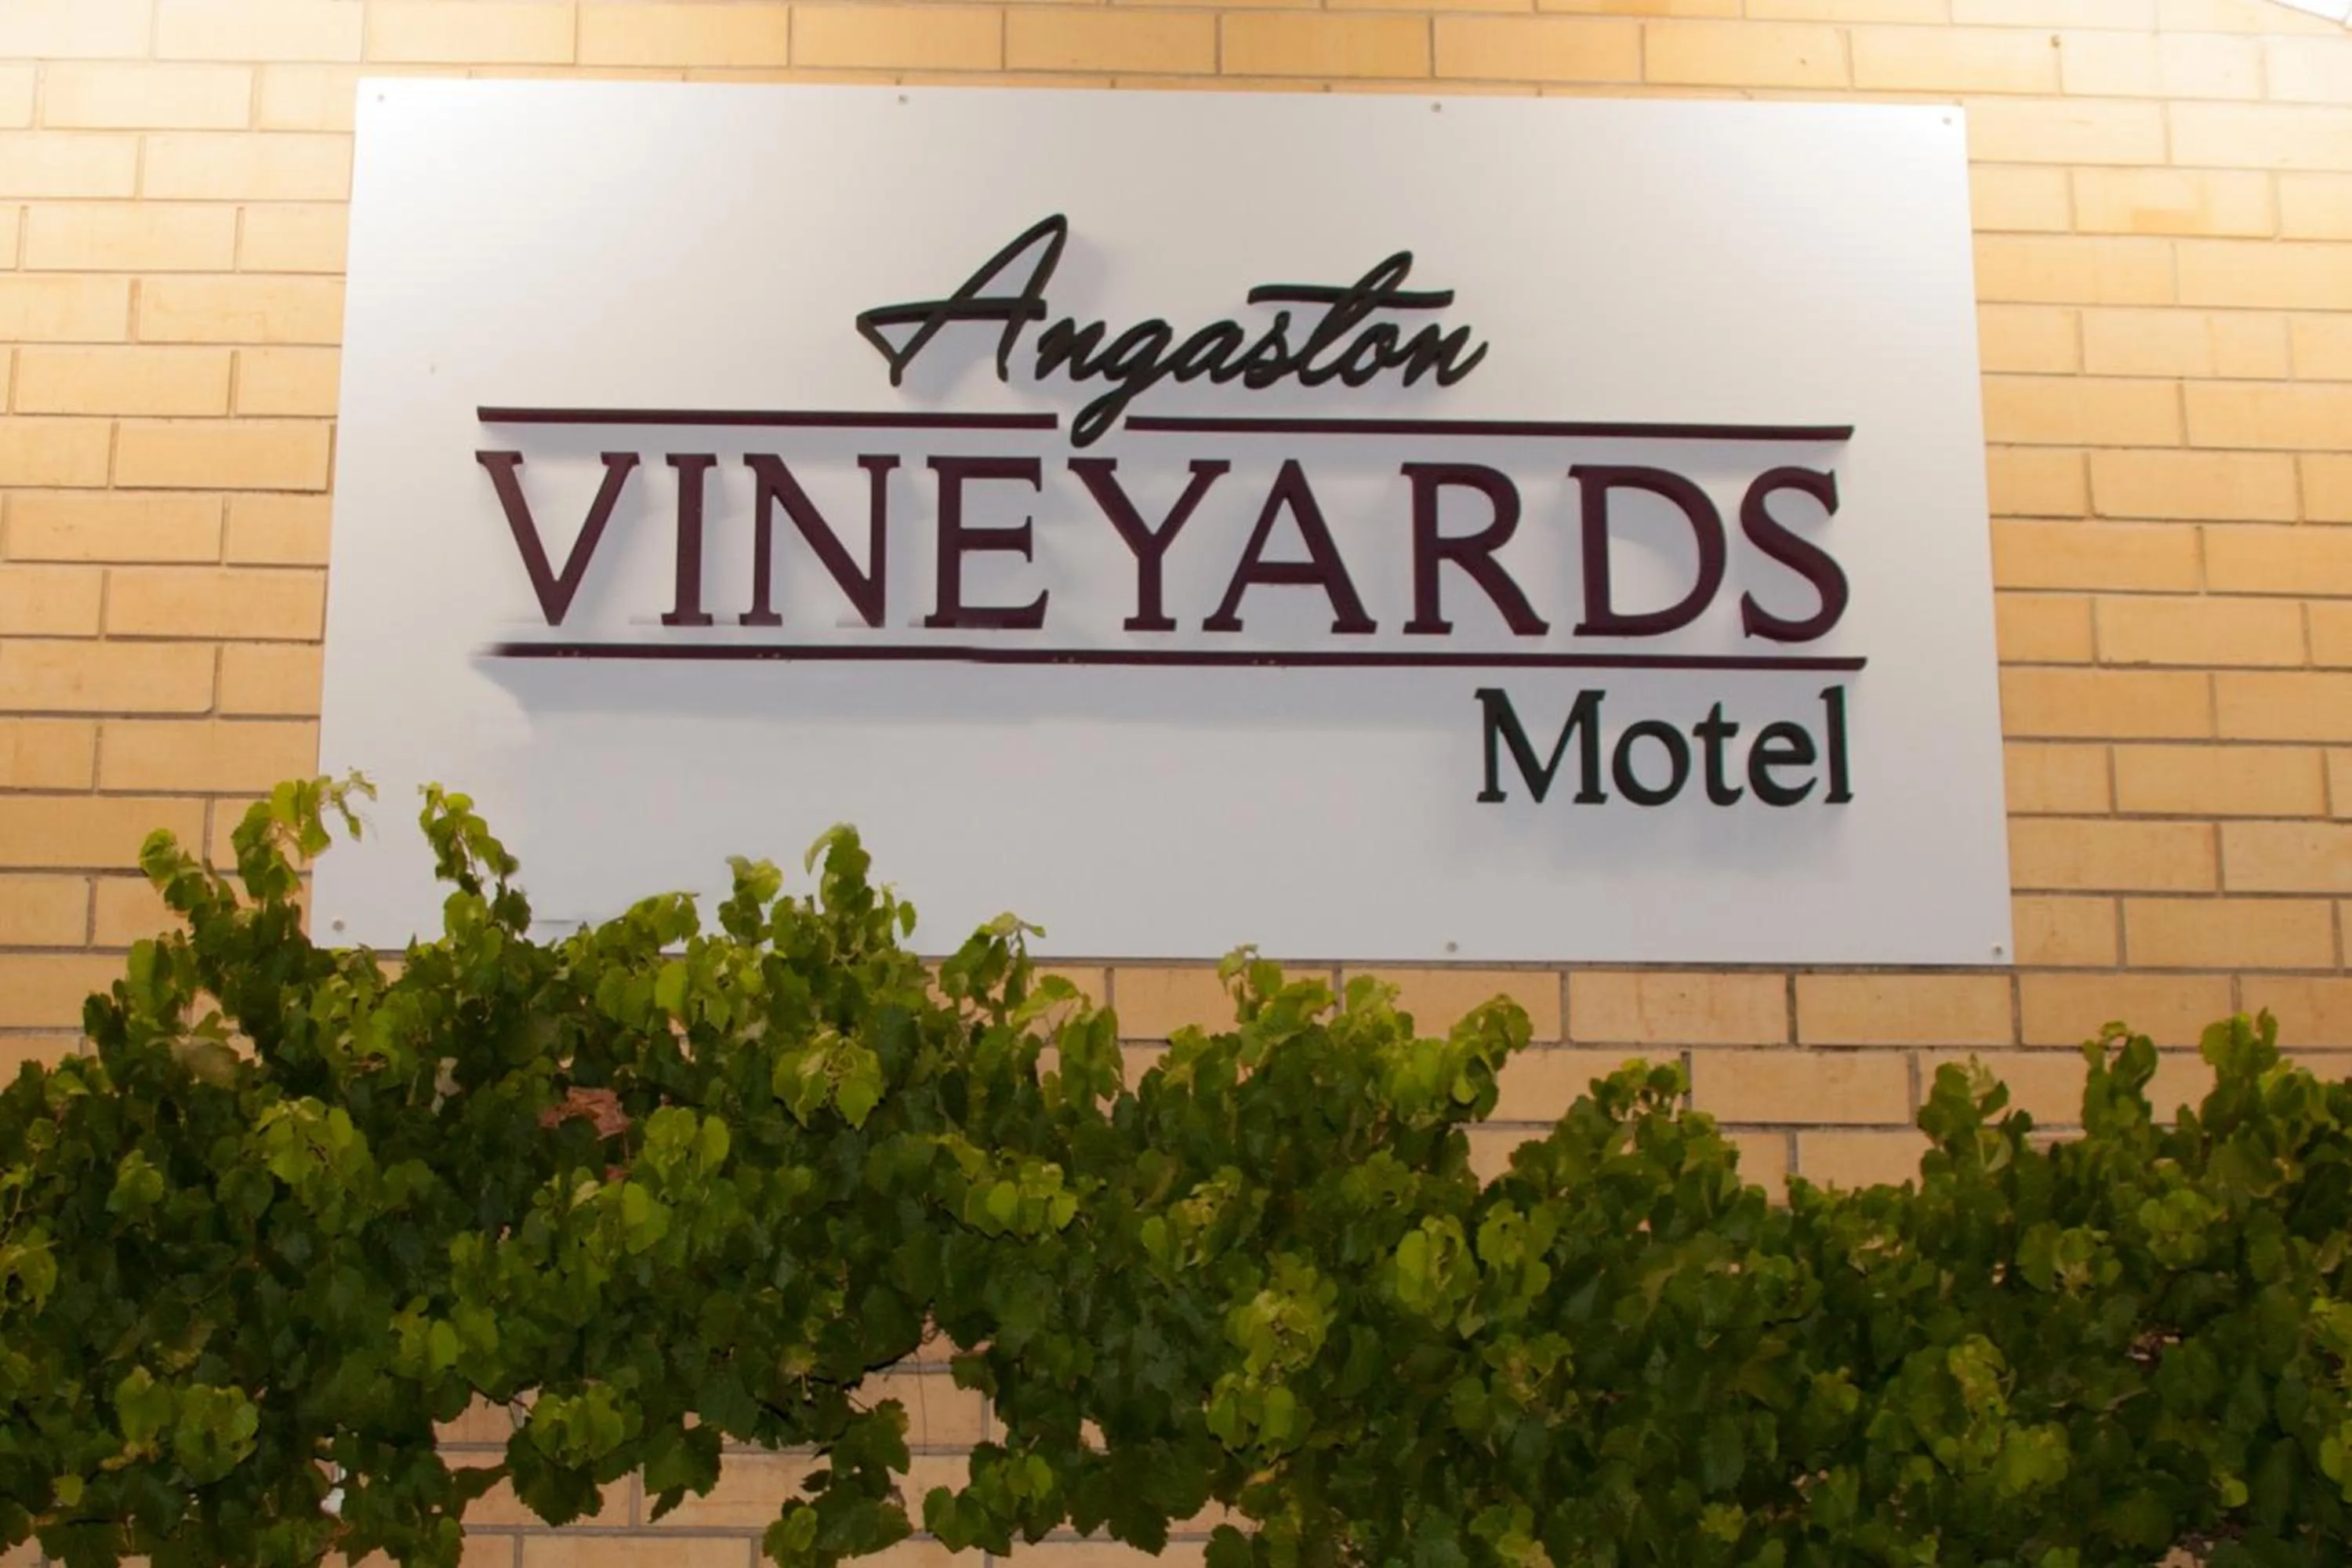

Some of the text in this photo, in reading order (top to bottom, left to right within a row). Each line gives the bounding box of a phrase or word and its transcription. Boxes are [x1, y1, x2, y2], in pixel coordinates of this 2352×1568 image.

[856, 213, 1489, 450] Angaston
[475, 451, 1849, 643] VINEYARDS
[1474, 684, 1854, 808] Motel
